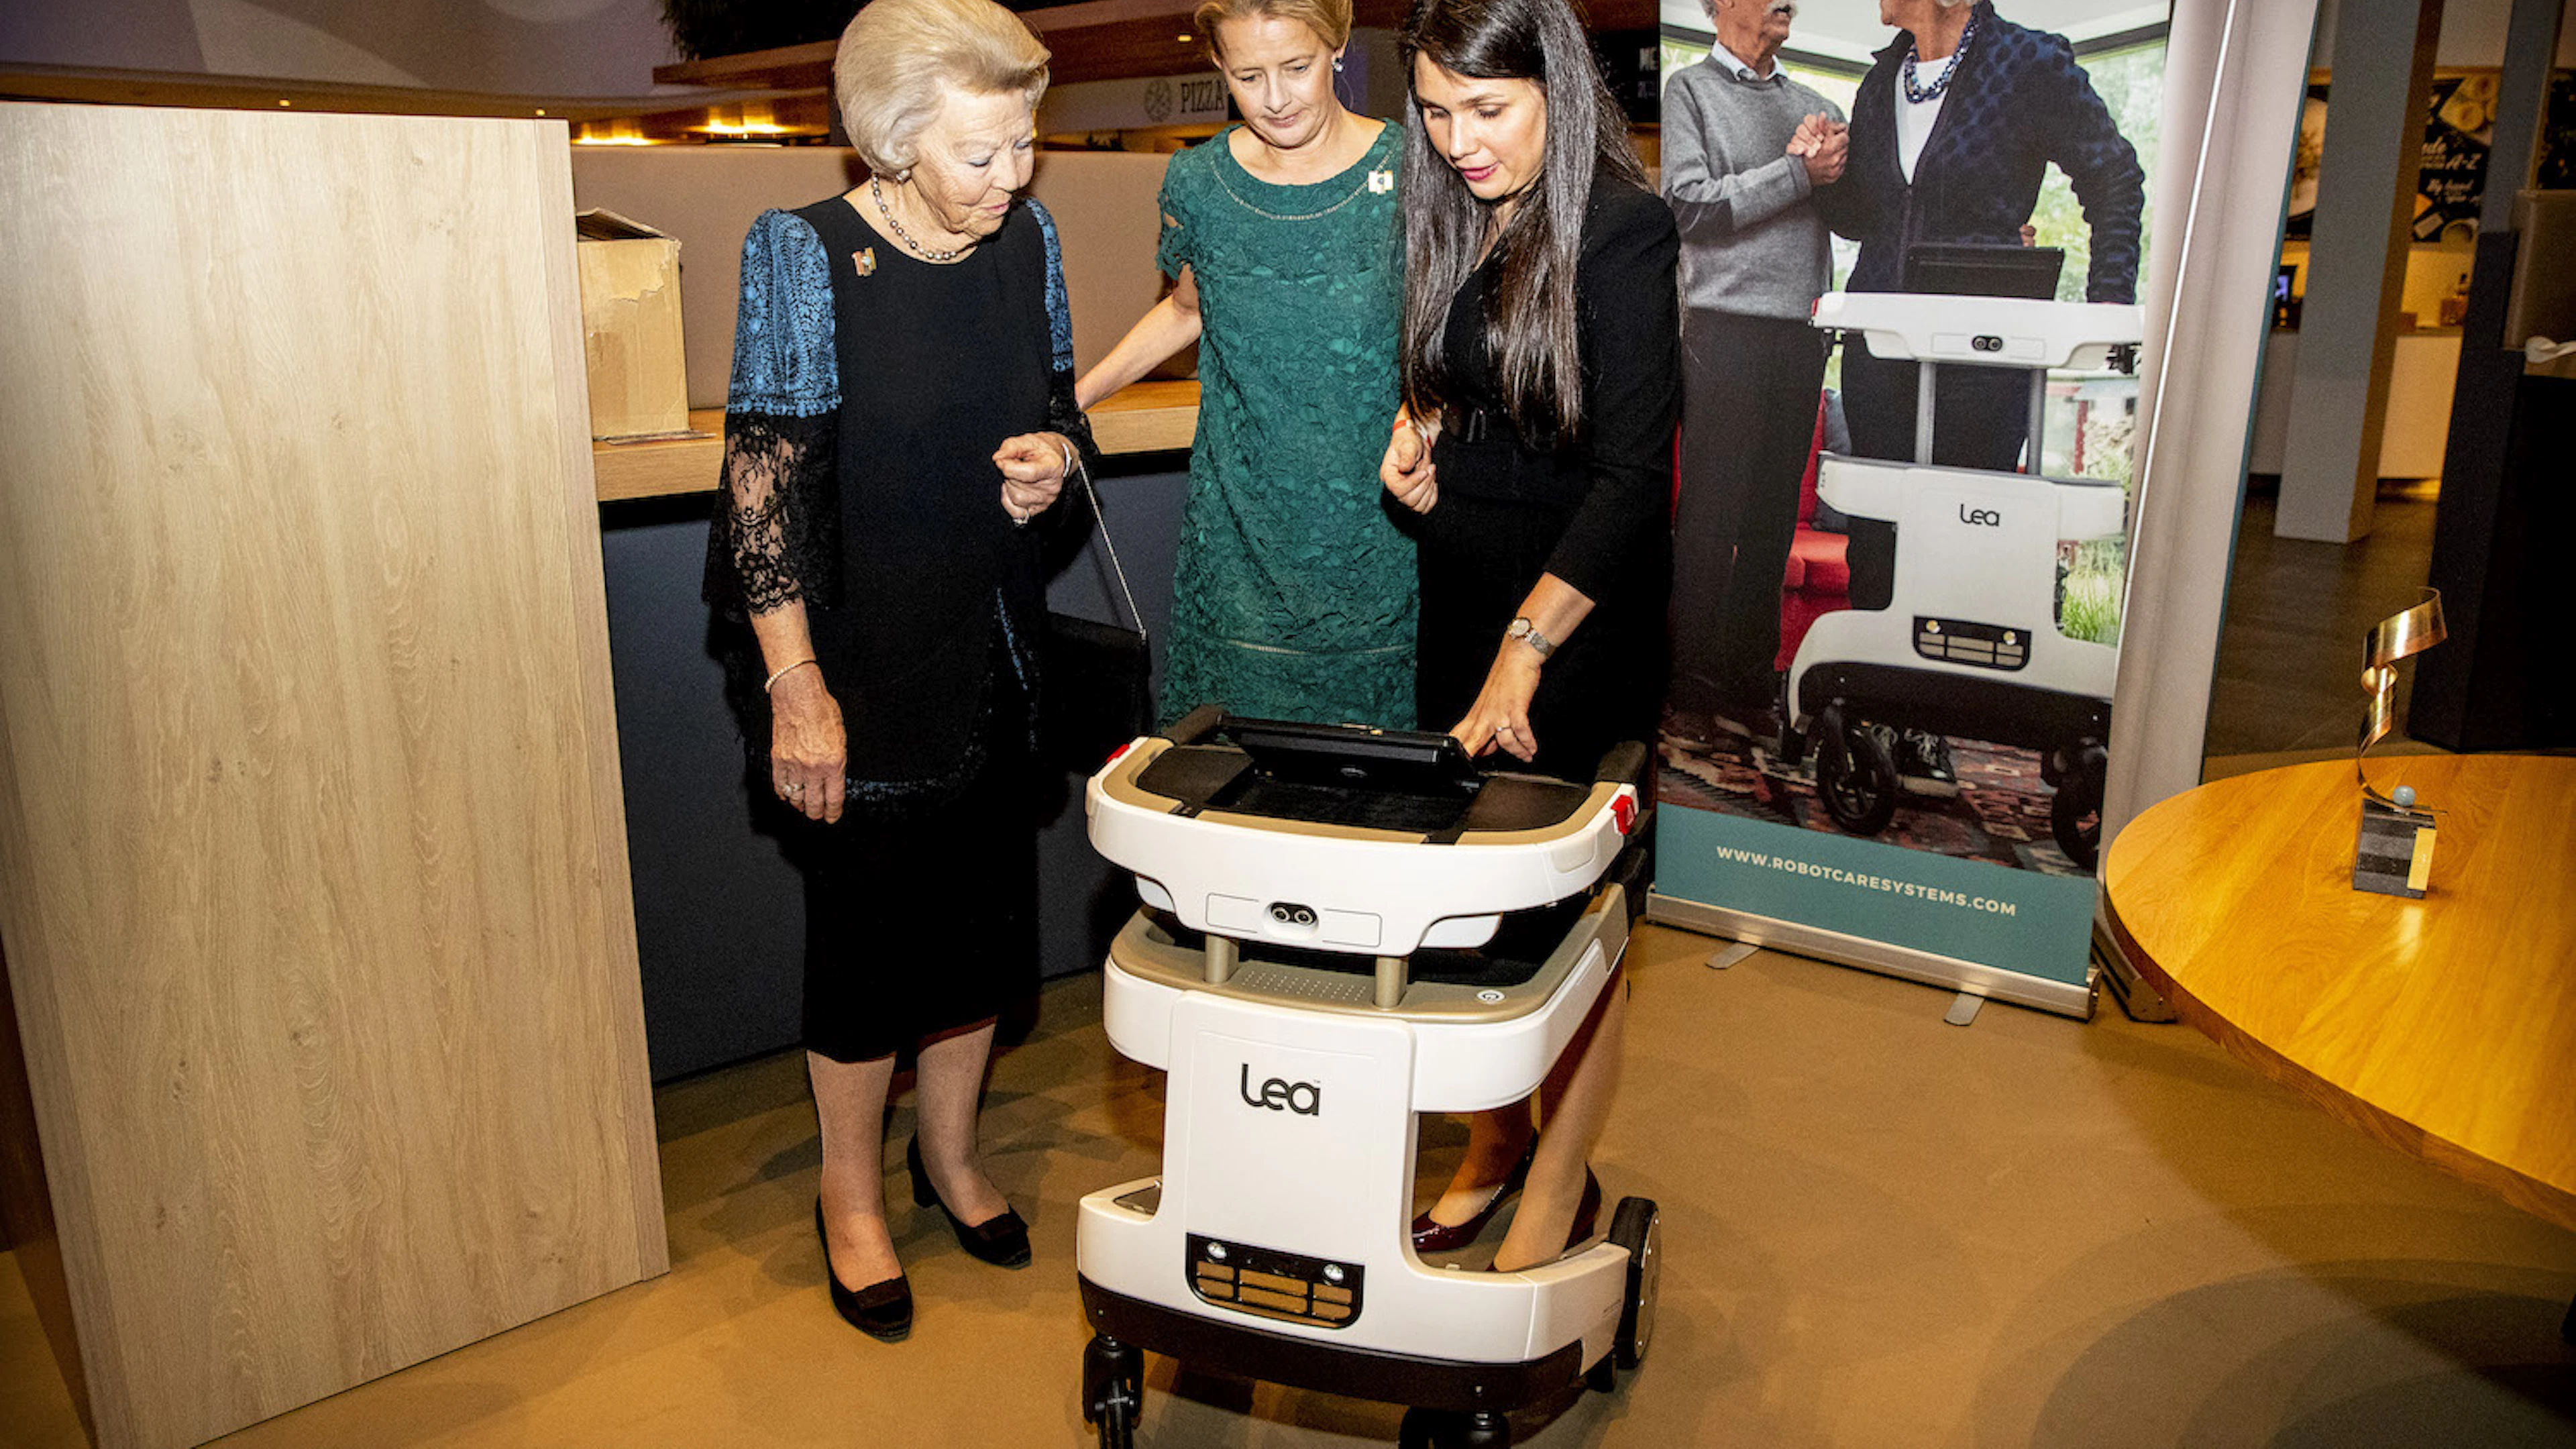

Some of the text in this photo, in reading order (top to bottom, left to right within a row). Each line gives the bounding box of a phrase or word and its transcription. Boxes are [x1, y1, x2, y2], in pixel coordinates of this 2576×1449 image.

[1181, 80, 1225, 113] PIZZA
[1960, 503, 2000, 527] Lea
[1716, 845, 2017, 916] WWW.ROBOTCARESYSTEMS.COM
[1241, 1063, 1320, 1116] Lea
